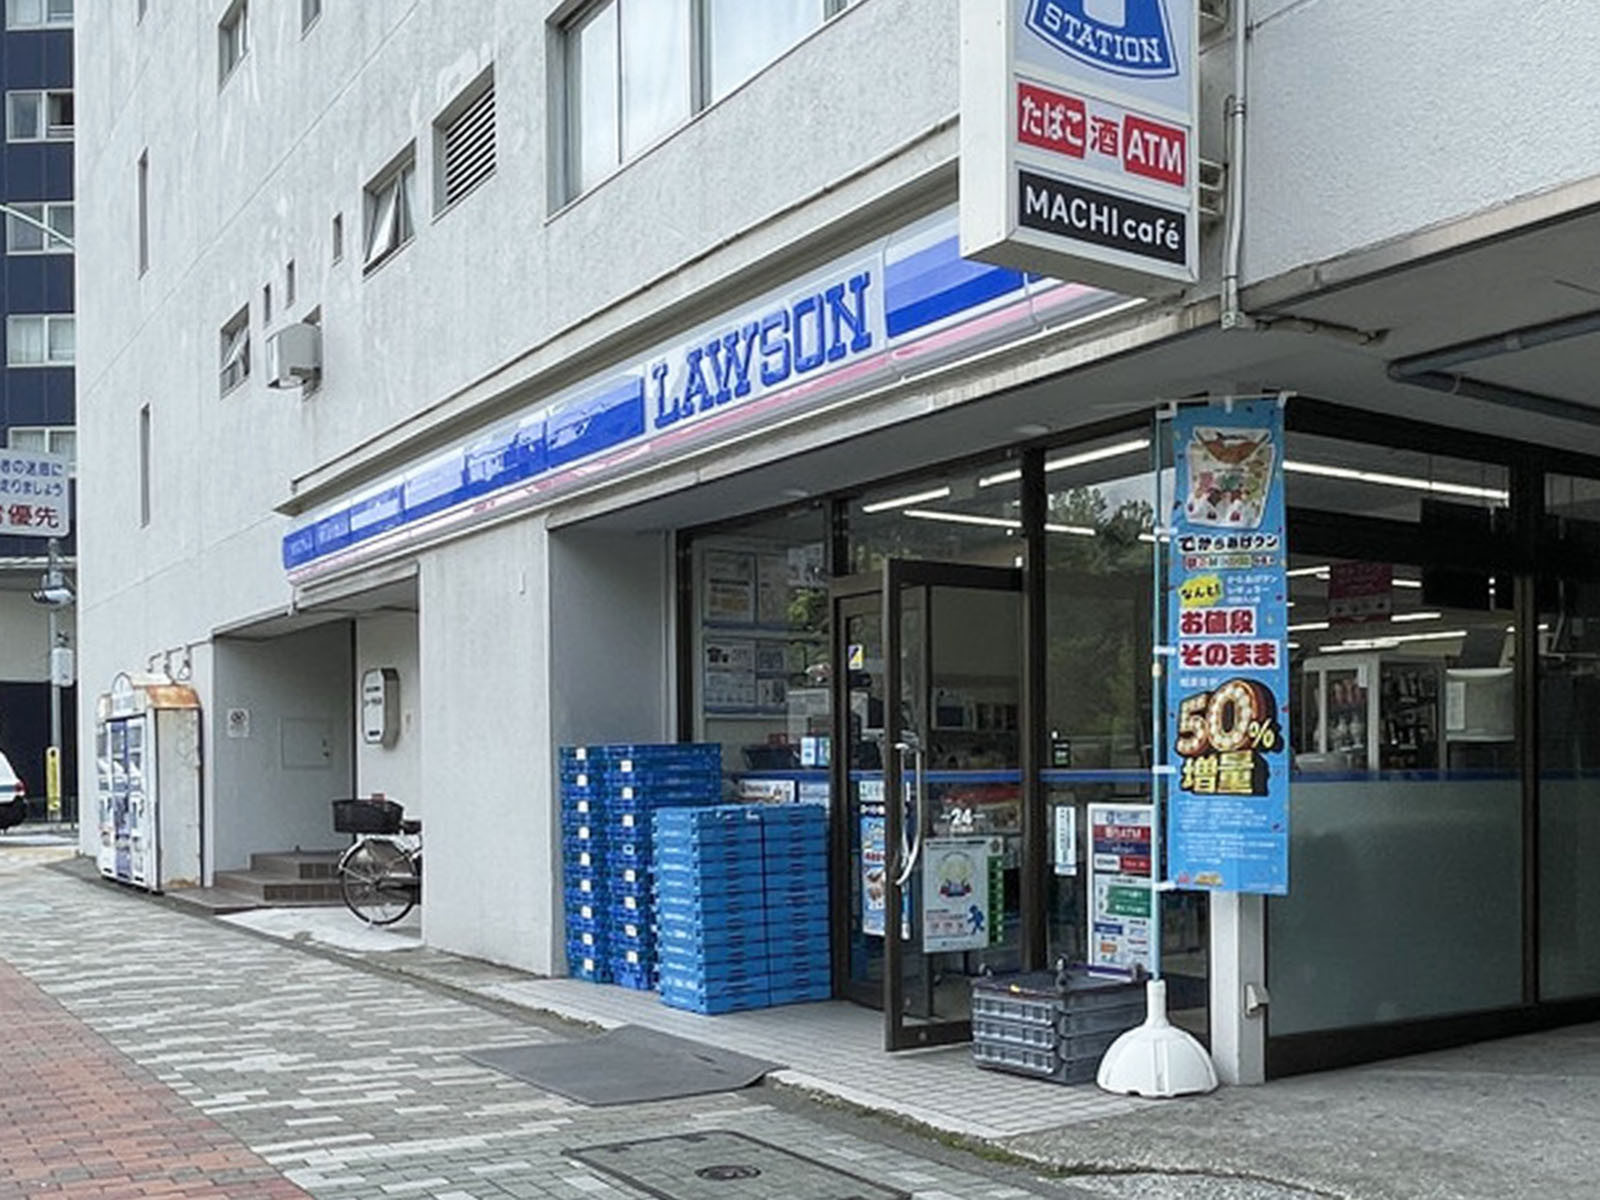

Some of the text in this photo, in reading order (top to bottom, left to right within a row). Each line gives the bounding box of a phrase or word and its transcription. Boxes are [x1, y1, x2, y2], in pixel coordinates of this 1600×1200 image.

[1043, 5, 1163, 63] STATION
[1021, 96, 1183, 174] たばこ 酒 ATM
[1025, 186, 1179, 249] MACHI café
[653, 272, 872, 429] LAWSON
[0, 504, 60, 529] 優先
[1181, 609, 1254, 634] お値段
[1180, 643, 1276, 667] そのまま
[1181, 750, 1255, 793] 増量
